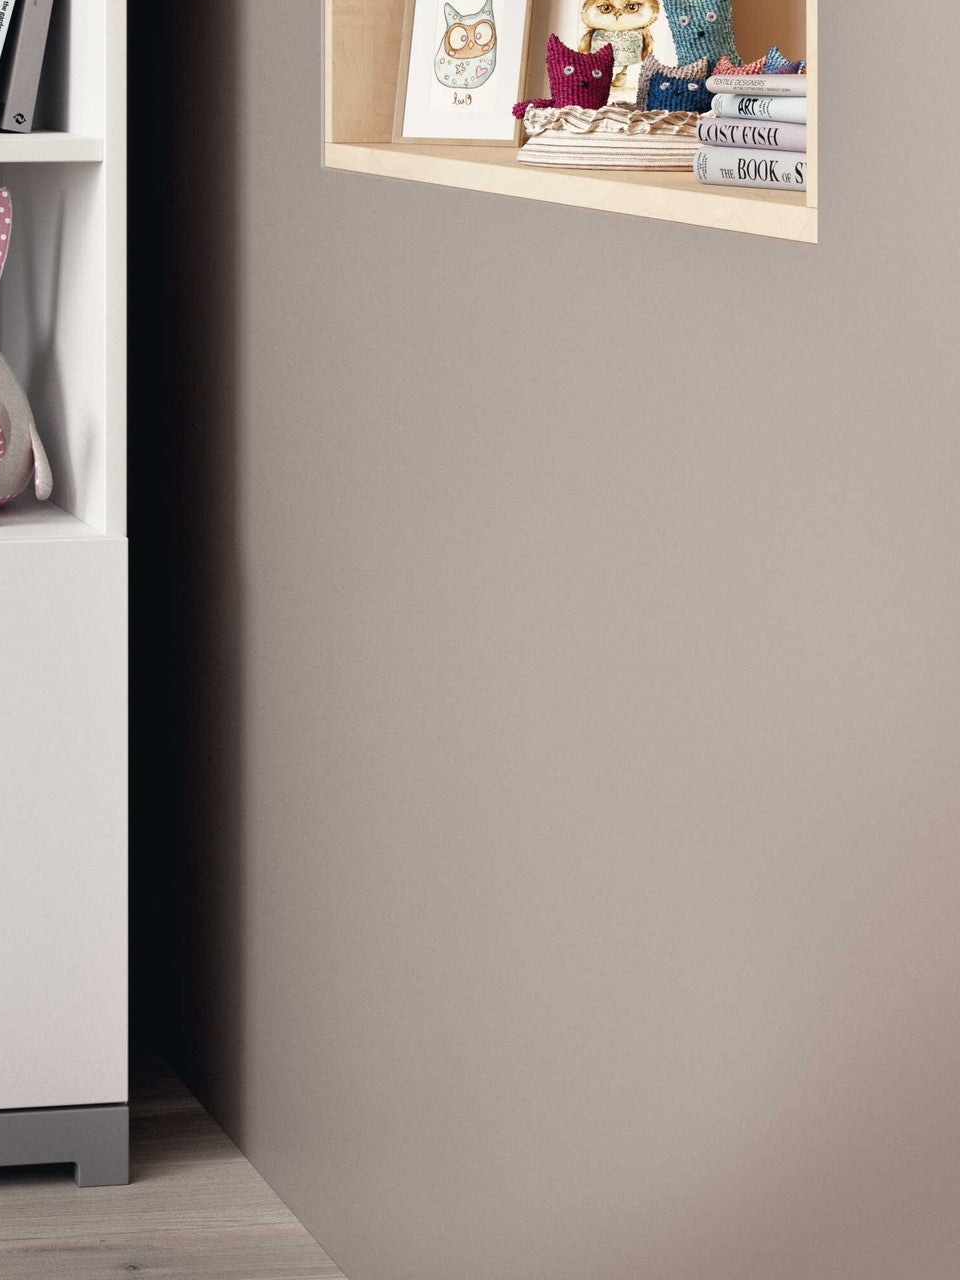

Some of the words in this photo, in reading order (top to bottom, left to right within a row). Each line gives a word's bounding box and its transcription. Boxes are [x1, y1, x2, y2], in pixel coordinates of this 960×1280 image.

[737, 97, 759, 116] ART
[698, 123, 739, 144] LOST
[742, 125, 780, 146] FISH
[720, 168, 735, 179] THE
[737, 158, 780, 183] BOOK
[781, 172, 792, 183] OF
